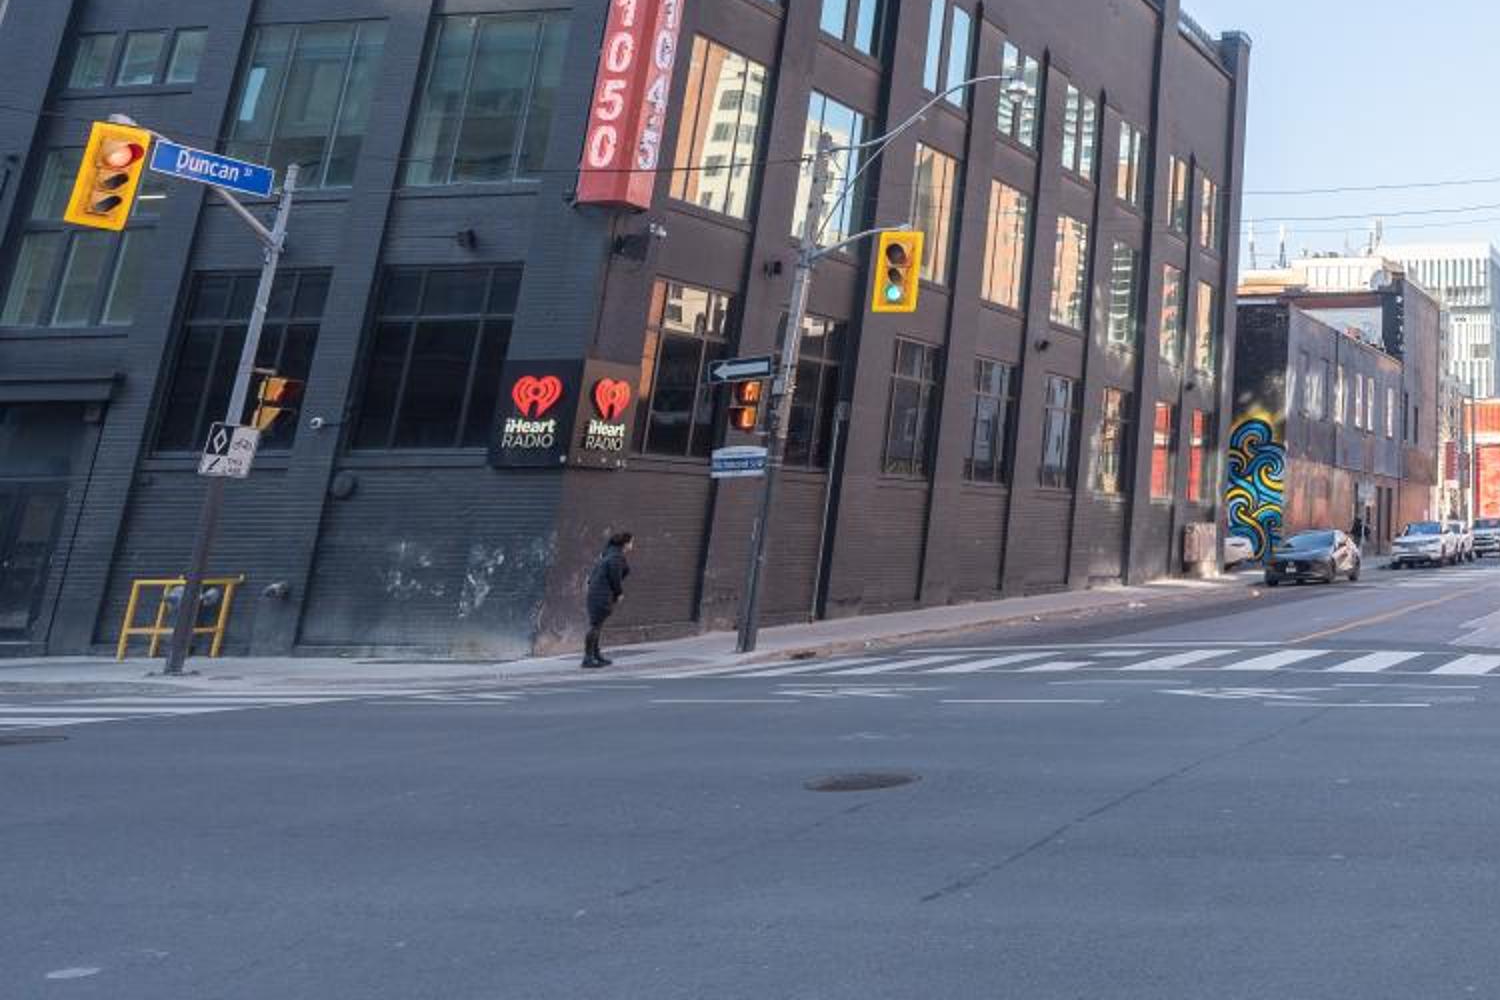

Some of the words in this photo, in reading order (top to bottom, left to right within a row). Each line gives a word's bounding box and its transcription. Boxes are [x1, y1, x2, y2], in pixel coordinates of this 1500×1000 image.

[175, 149, 240, 182] Duncan
[503, 417, 555, 433] iHeart
[587, 418, 625, 437] iHeart
[501, 433, 555, 449] RADIO
[585, 435, 624, 452] RADIO
